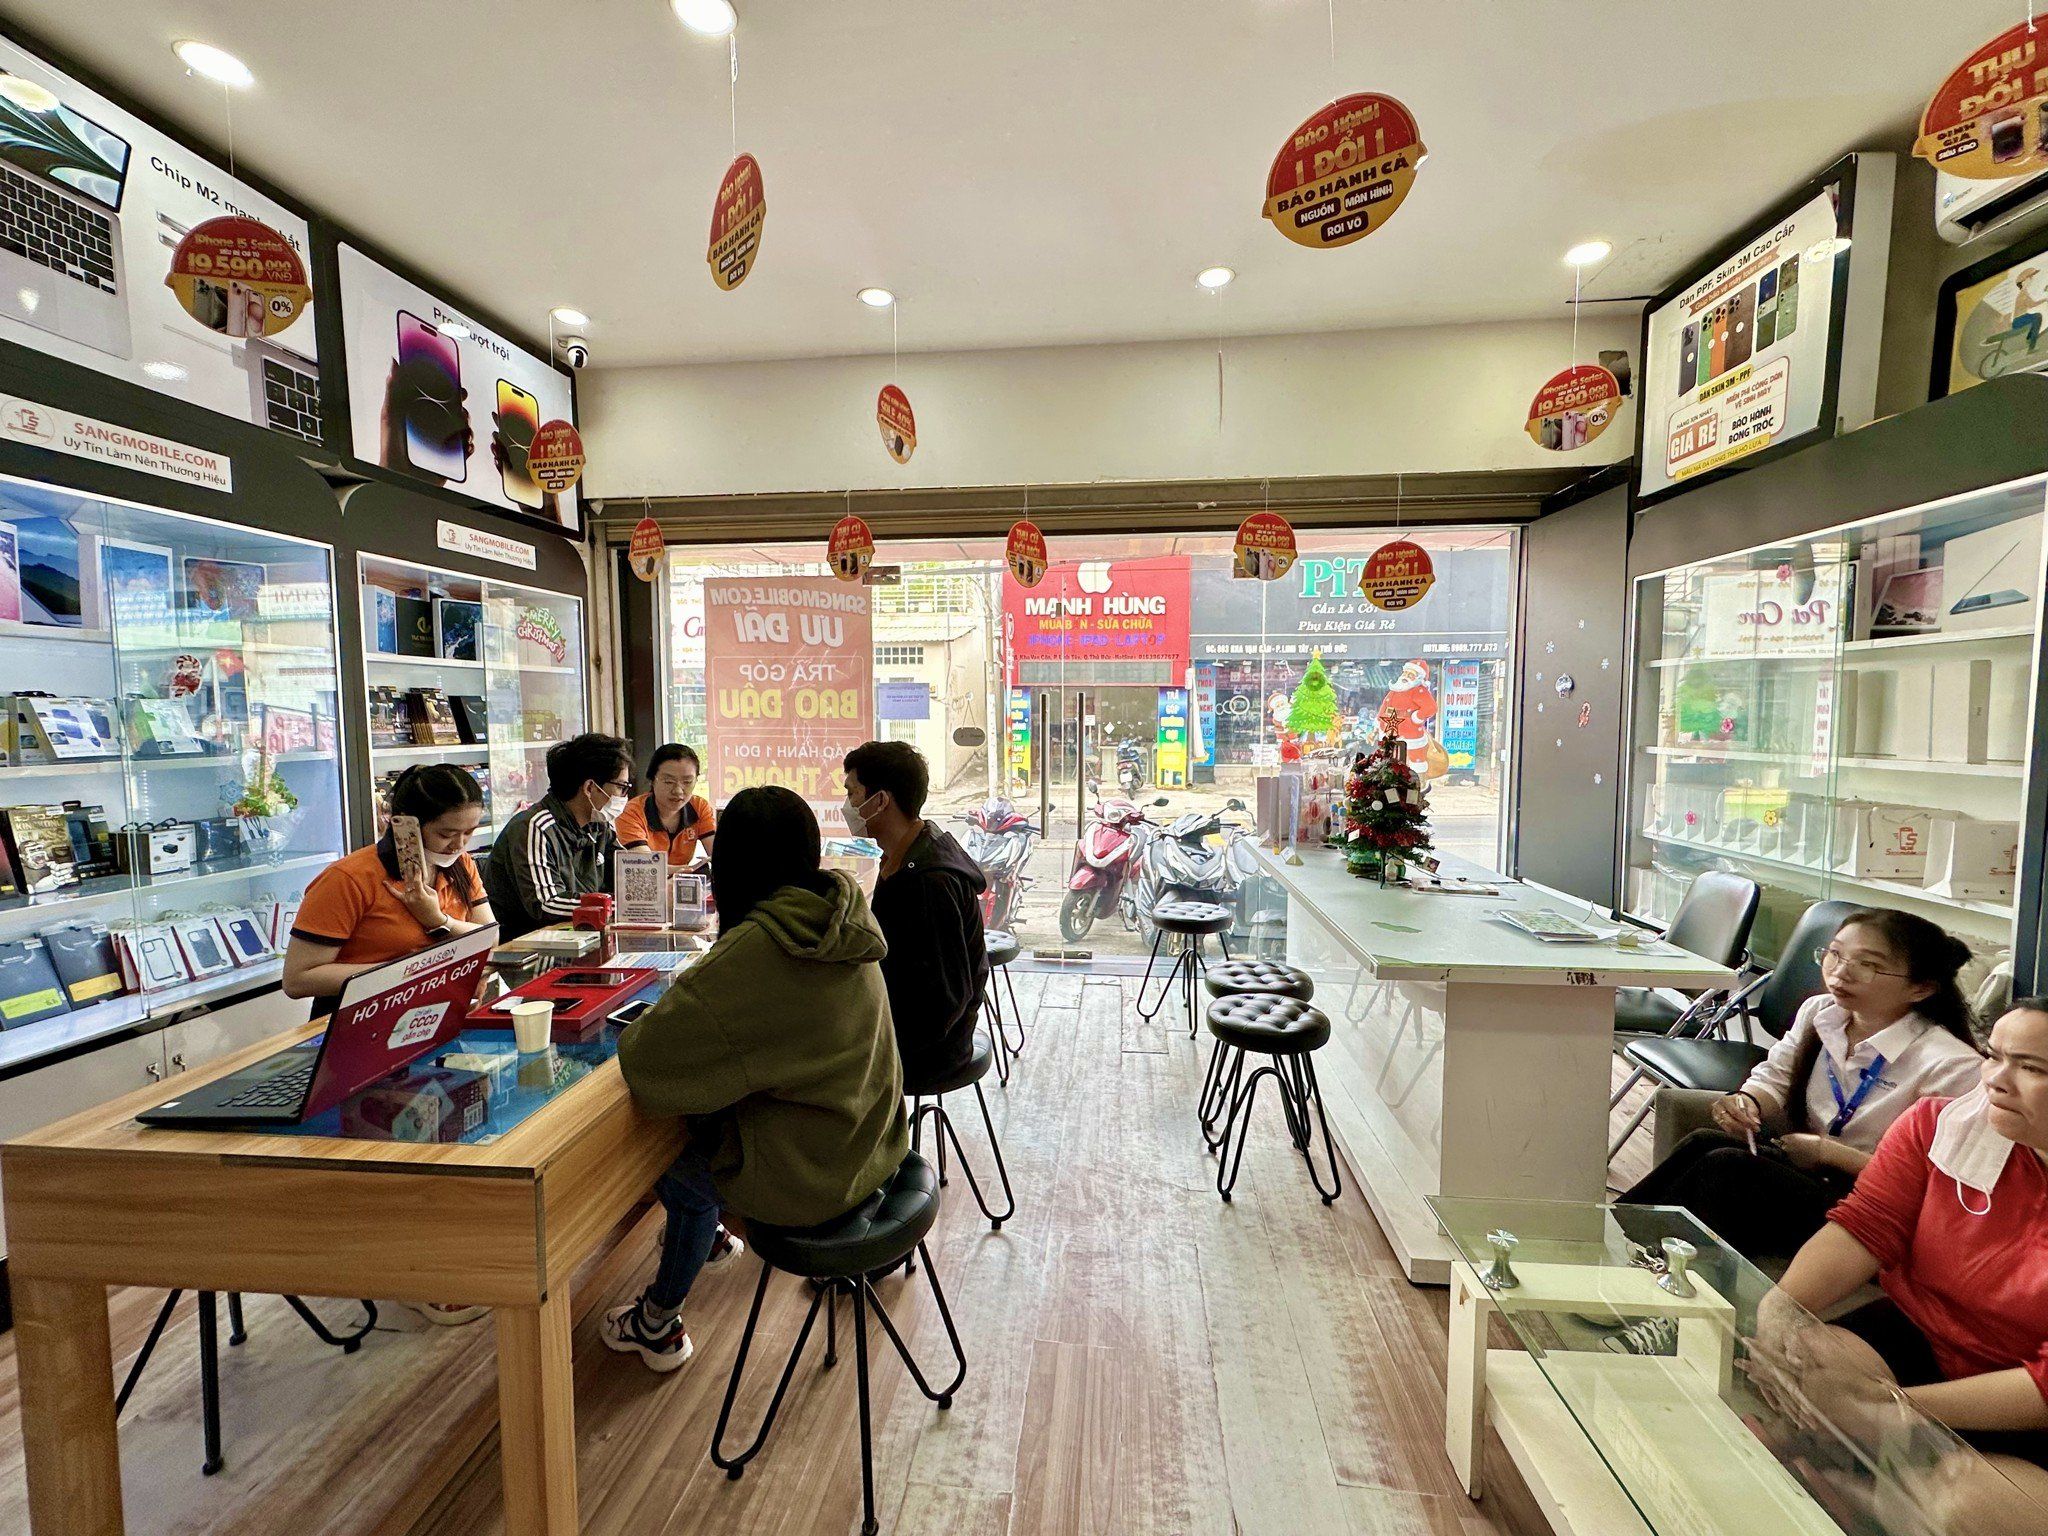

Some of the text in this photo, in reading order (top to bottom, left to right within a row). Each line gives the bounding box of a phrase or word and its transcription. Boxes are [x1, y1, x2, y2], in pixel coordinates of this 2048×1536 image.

[1968, 40, 2036, 86] THU
[1959, 73, 2023, 120] ĐỔI
[1314, 130, 1366, 178] ĐỔI
[151, 156, 220, 206] Chip M2
[1277, 153, 1409, 213] BẢO HÀNH CẢ
[1345, 194, 1368, 208] MÀN
[1370, 184, 1393, 200] HÌNH
[1680, 294, 1695, 309] Dán
[1716, 265, 1735, 284] Skin
[1737, 252, 1751, 269] 3M
[1753, 240, 1772, 257] Cao
[1774, 223, 1795, 242] Cấp
[271, 300, 291, 313] 0%
[492, 342, 510, 361] trội
[1592, 413, 1606, 422] 0%
[74, 422, 217, 471] SANGMOBILE.COM
[1671, 427, 1693, 460] GIÁ
[1728, 428, 1750, 444] BONG
[64, 437, 227, 486] Uy Tín Làm Nên Thương Hiệu
[469, 533, 529, 555] SANGMOBILE.COM
[1025, 591, 1166, 618] MẠNH HÙNG
[1338, 604, 1354, 613] Là
[530, 607, 560, 639] MERRY
[1039, 617, 1153, 629] MUA SỬA CHỮA
[1297, 619, 1396, 633] Phụ Kiện Giá Rẻ
[352, 959, 479, 1025] HỖ TRỢ TRẢ GÓP
[409, 1013, 438, 1030] CCCD
